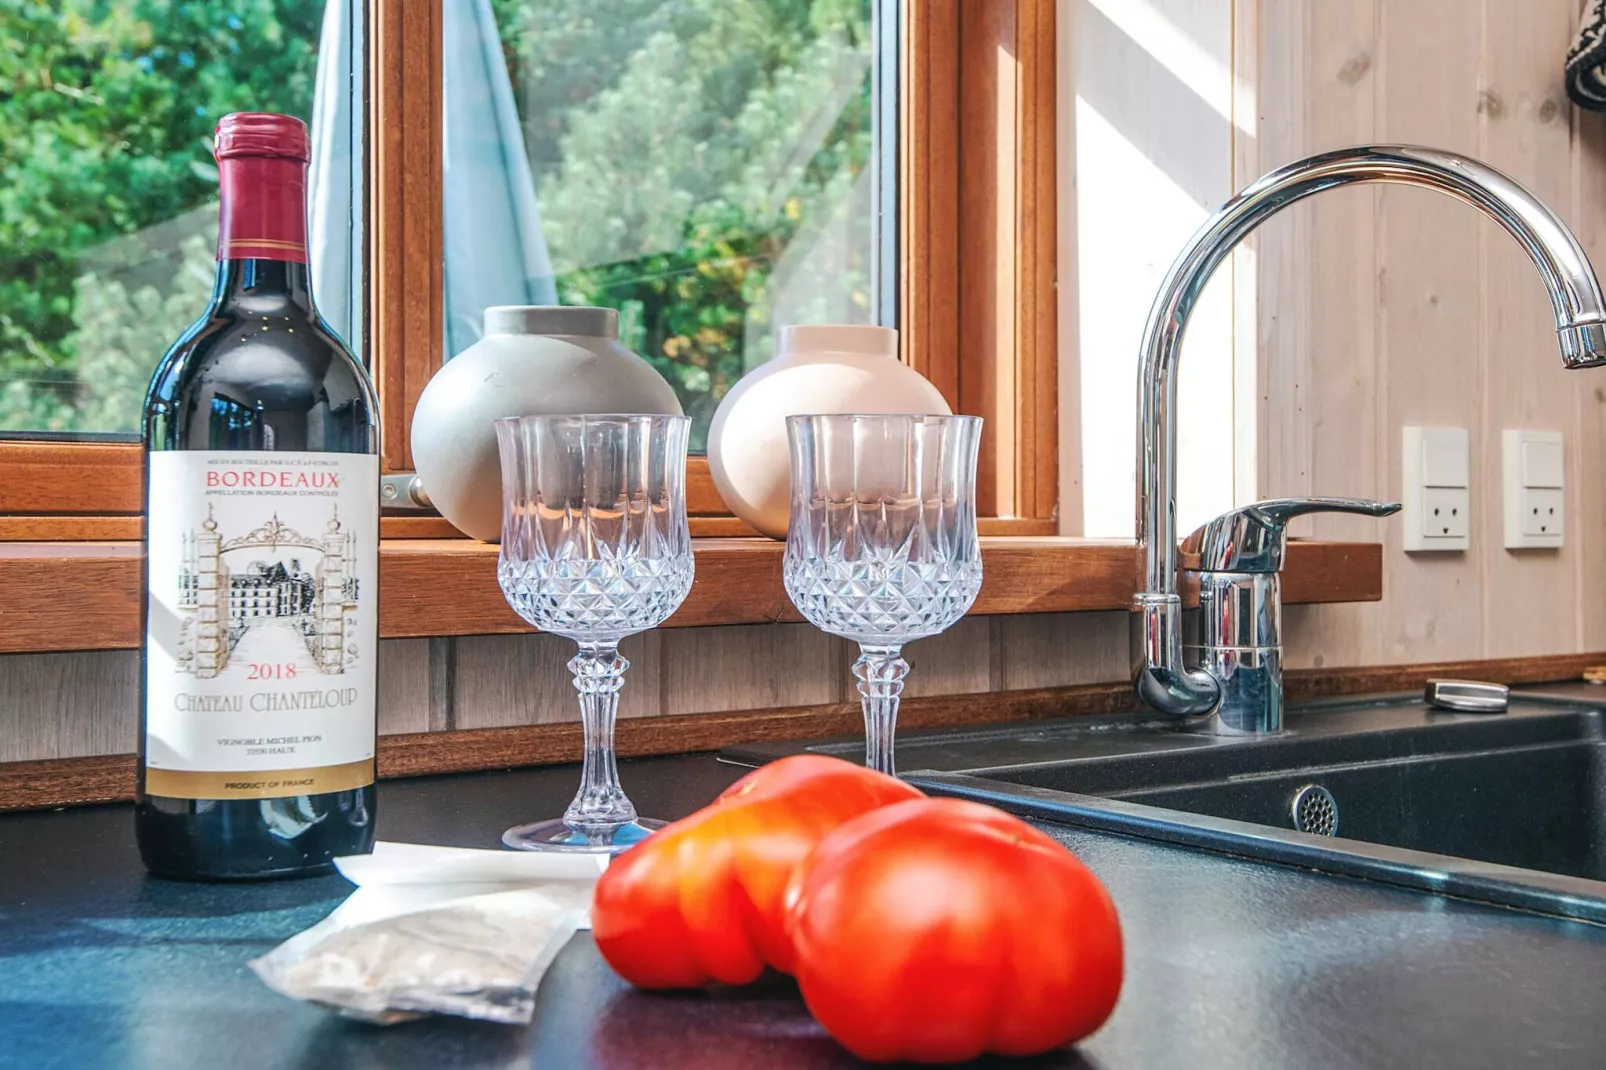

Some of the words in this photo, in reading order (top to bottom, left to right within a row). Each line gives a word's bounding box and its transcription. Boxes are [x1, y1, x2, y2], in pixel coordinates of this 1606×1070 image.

[206, 471, 339, 488] BORDEAUX
[205, 489, 254, 497] APPELLATION
[255, 489, 297, 497] BORDEAUX
[246, 662, 297, 680] 2018
[174, 692, 243, 713] CHATEAU
[249, 687, 358, 713] CHANTELOUP
[266, 736, 301, 745] MICHEL
[302, 735, 322, 743] PION
[224, 782, 266, 790] PRODUCT
[282, 778, 315, 787] FRANCE
